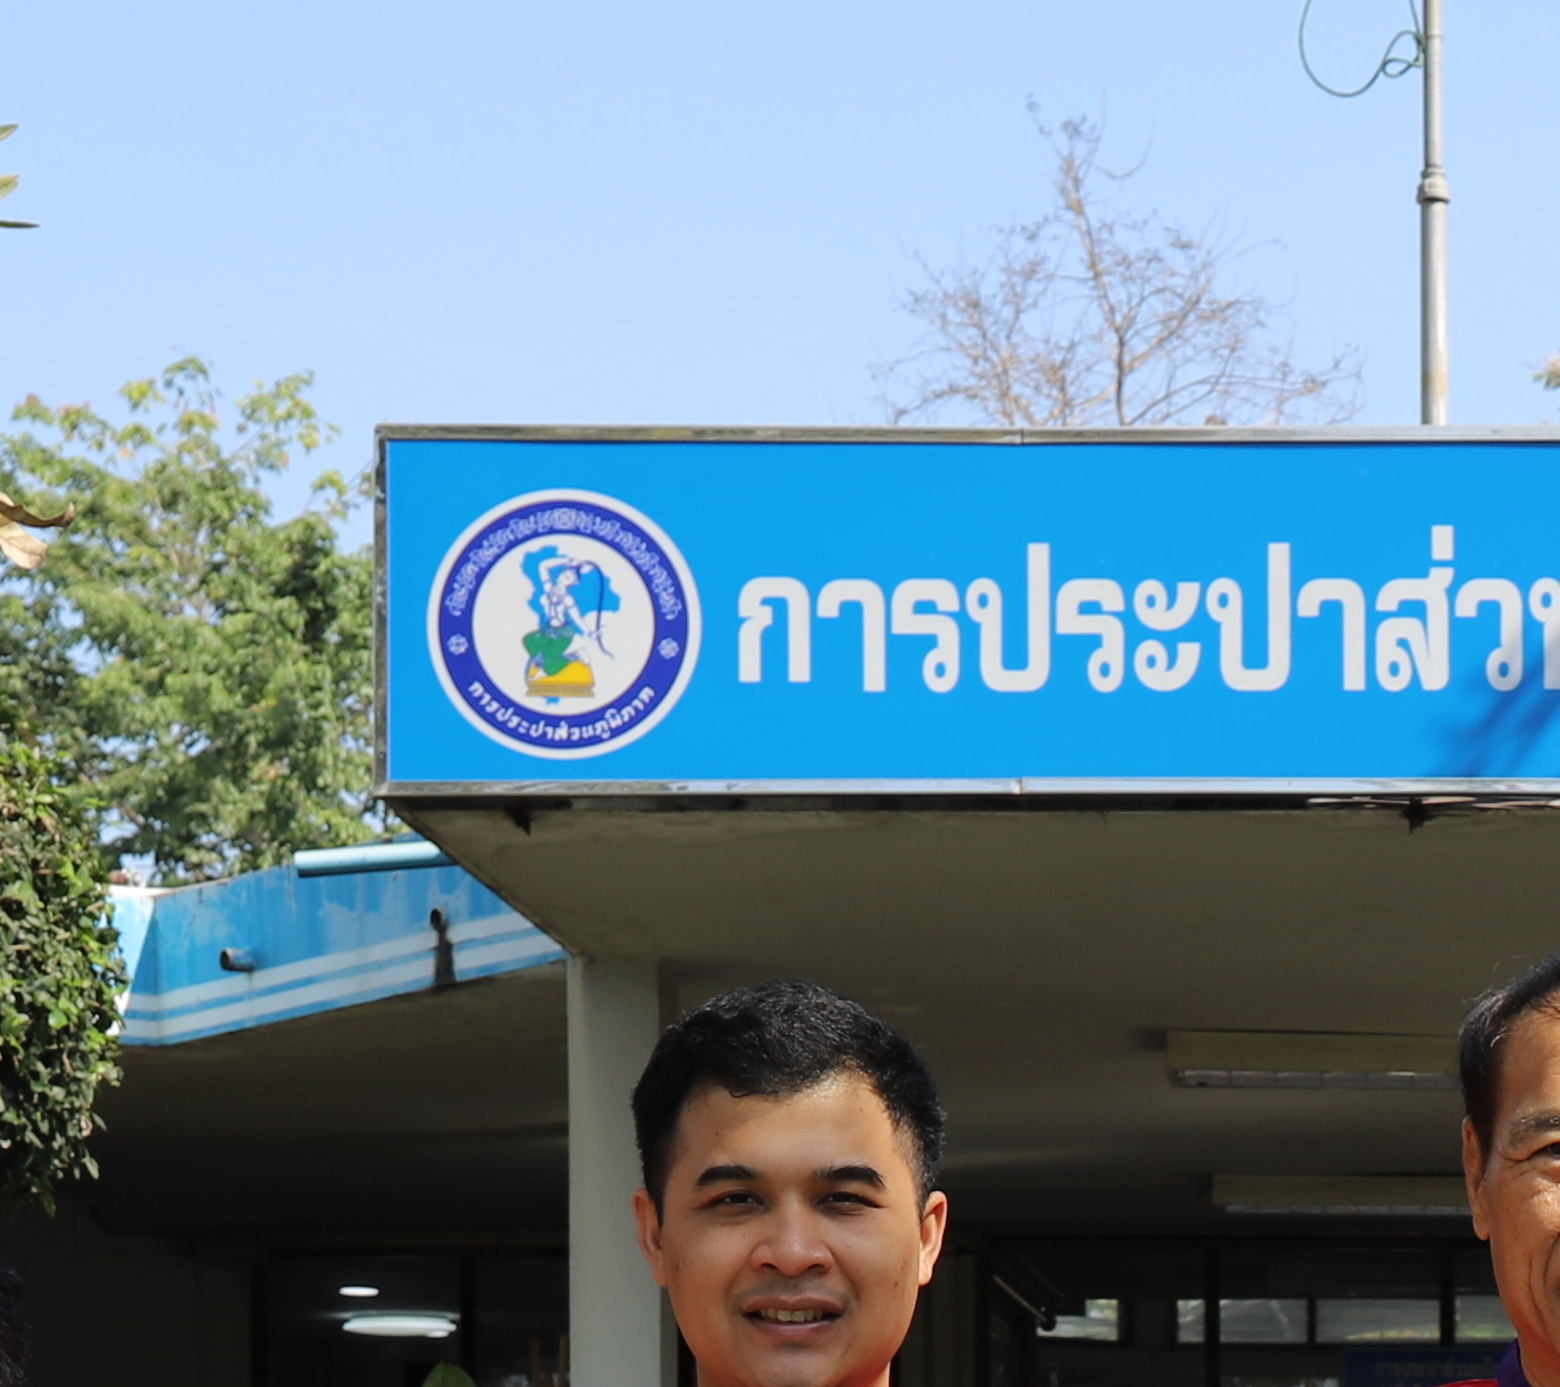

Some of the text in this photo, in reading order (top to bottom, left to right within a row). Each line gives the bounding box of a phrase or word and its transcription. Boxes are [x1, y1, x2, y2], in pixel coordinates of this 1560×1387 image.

[468, 680, 655, 739] การประปาส่วนภูมิภาค
